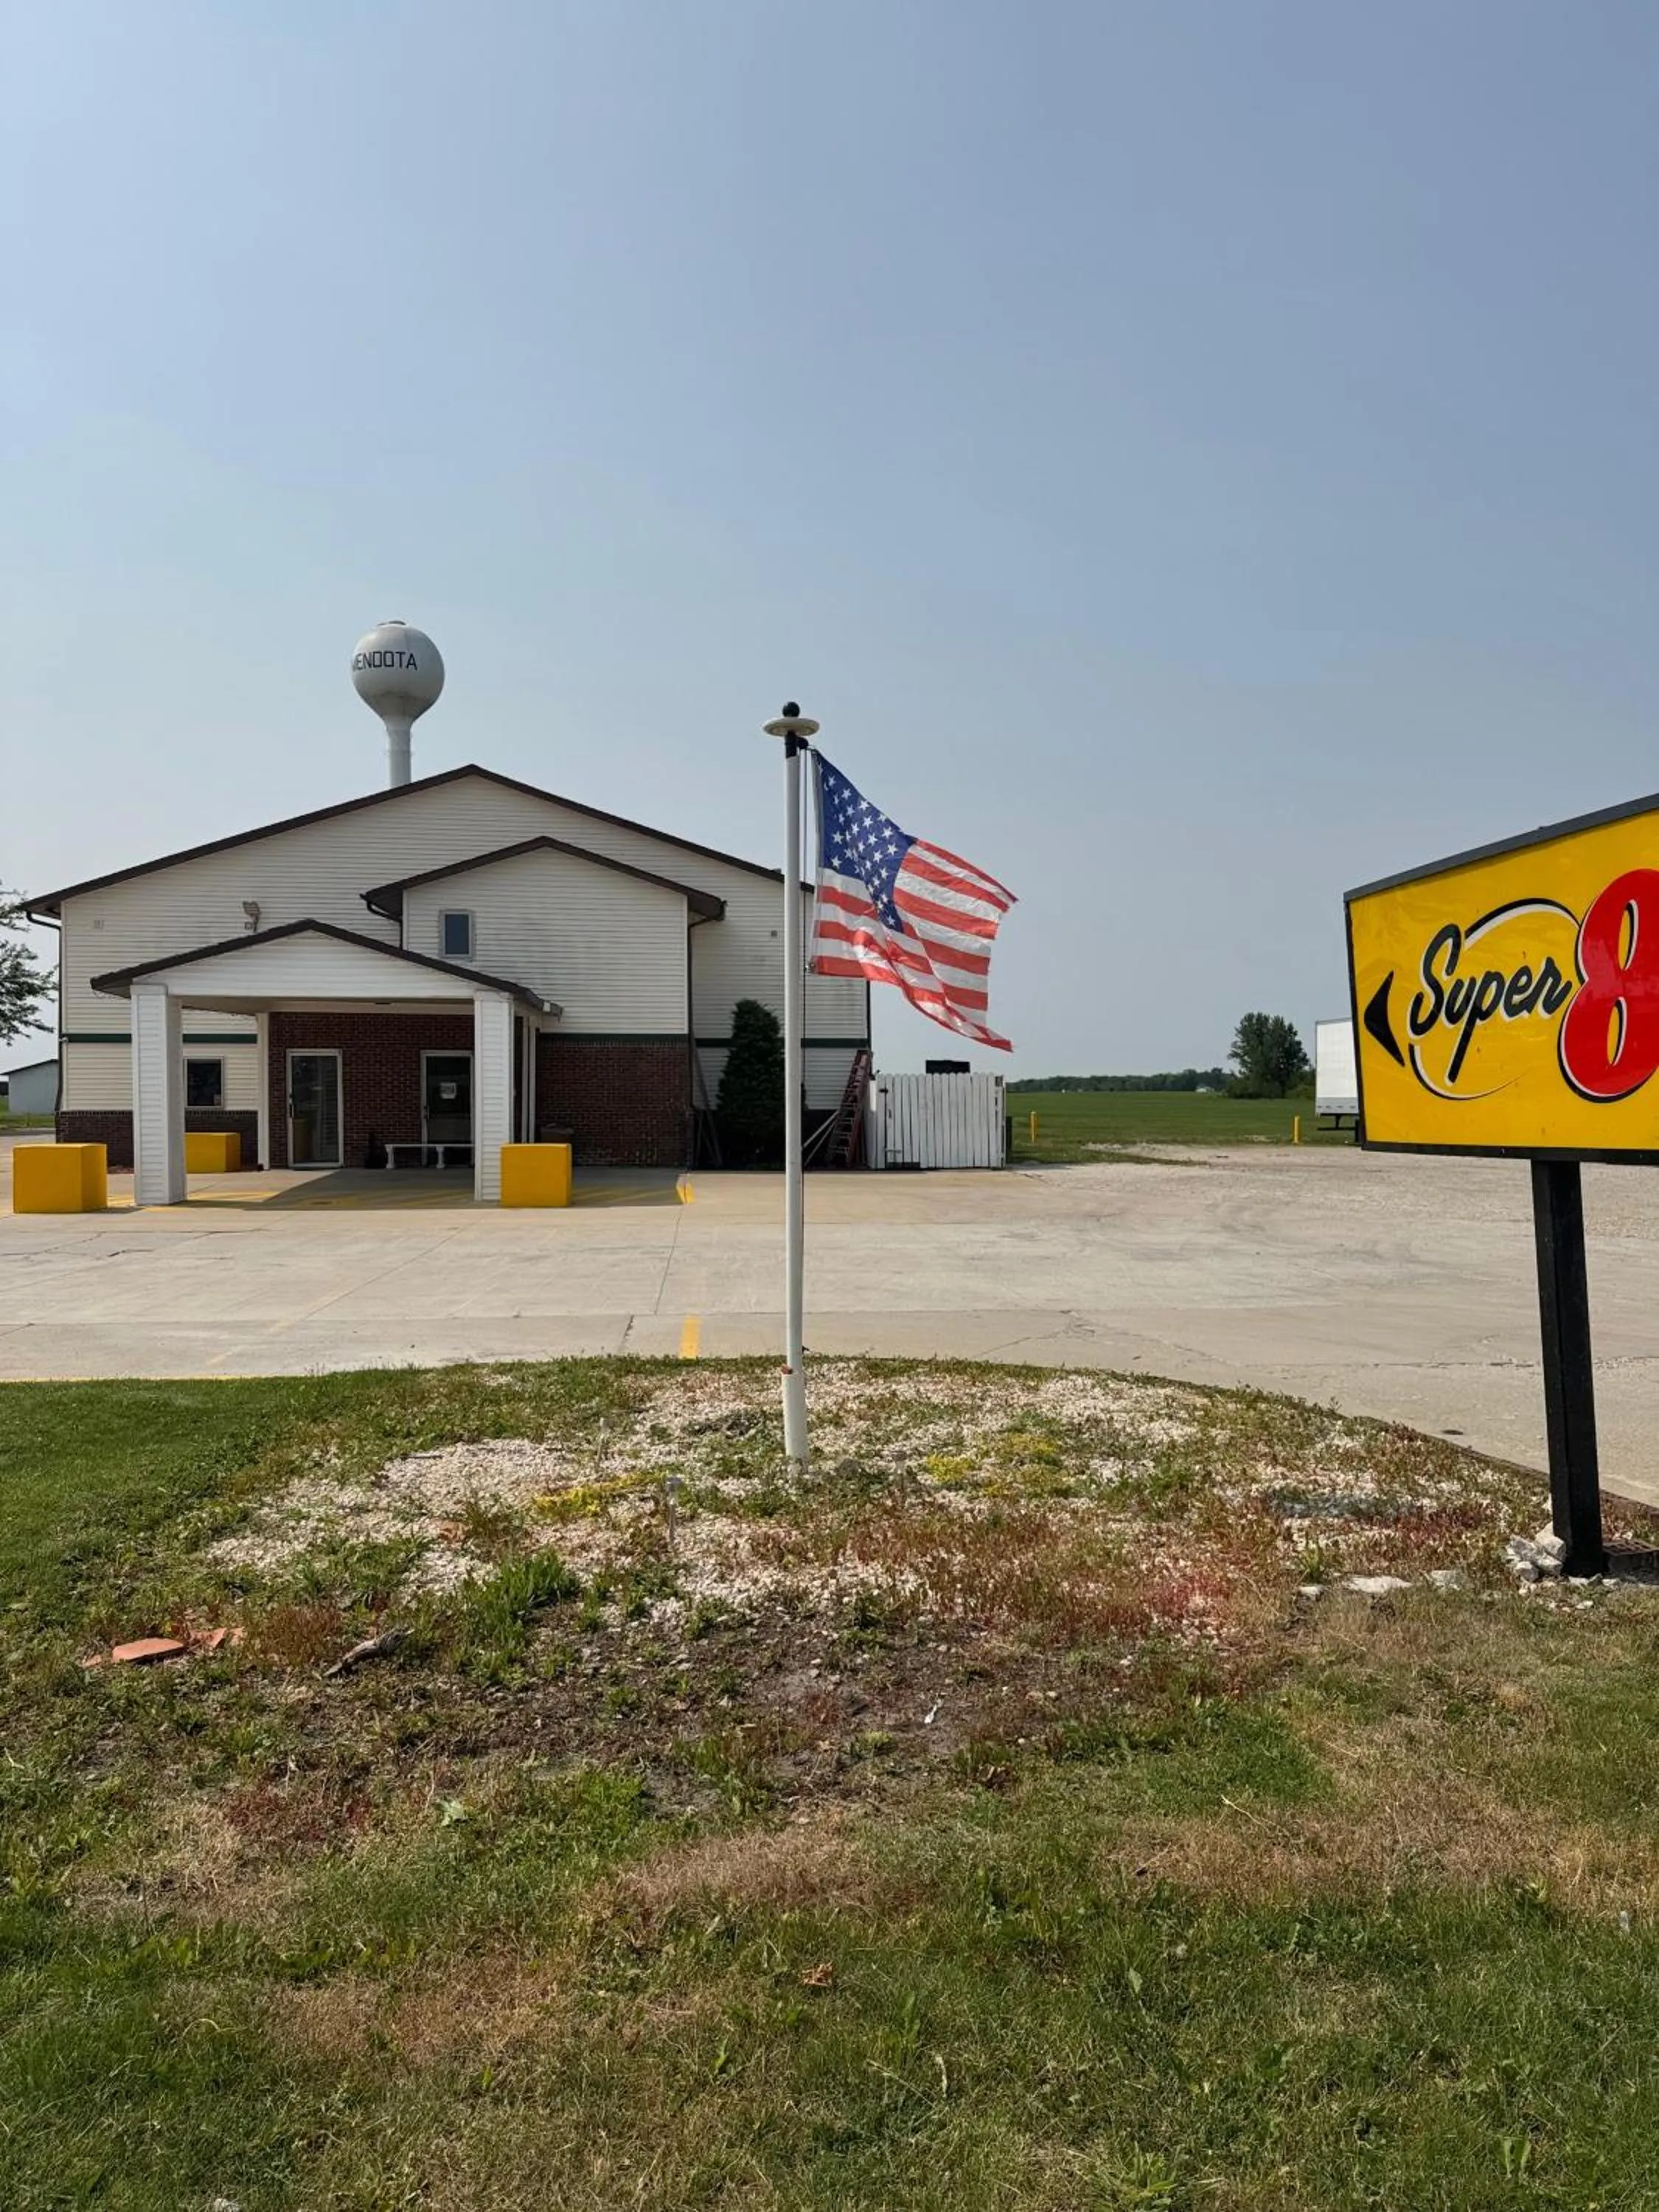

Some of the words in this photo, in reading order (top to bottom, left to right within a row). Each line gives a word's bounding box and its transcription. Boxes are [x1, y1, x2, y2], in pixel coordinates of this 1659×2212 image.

[352, 650, 418, 671] ENDOTA
[1407, 923, 1573, 1084] Super
[1558, 869, 1659, 1103] 8
